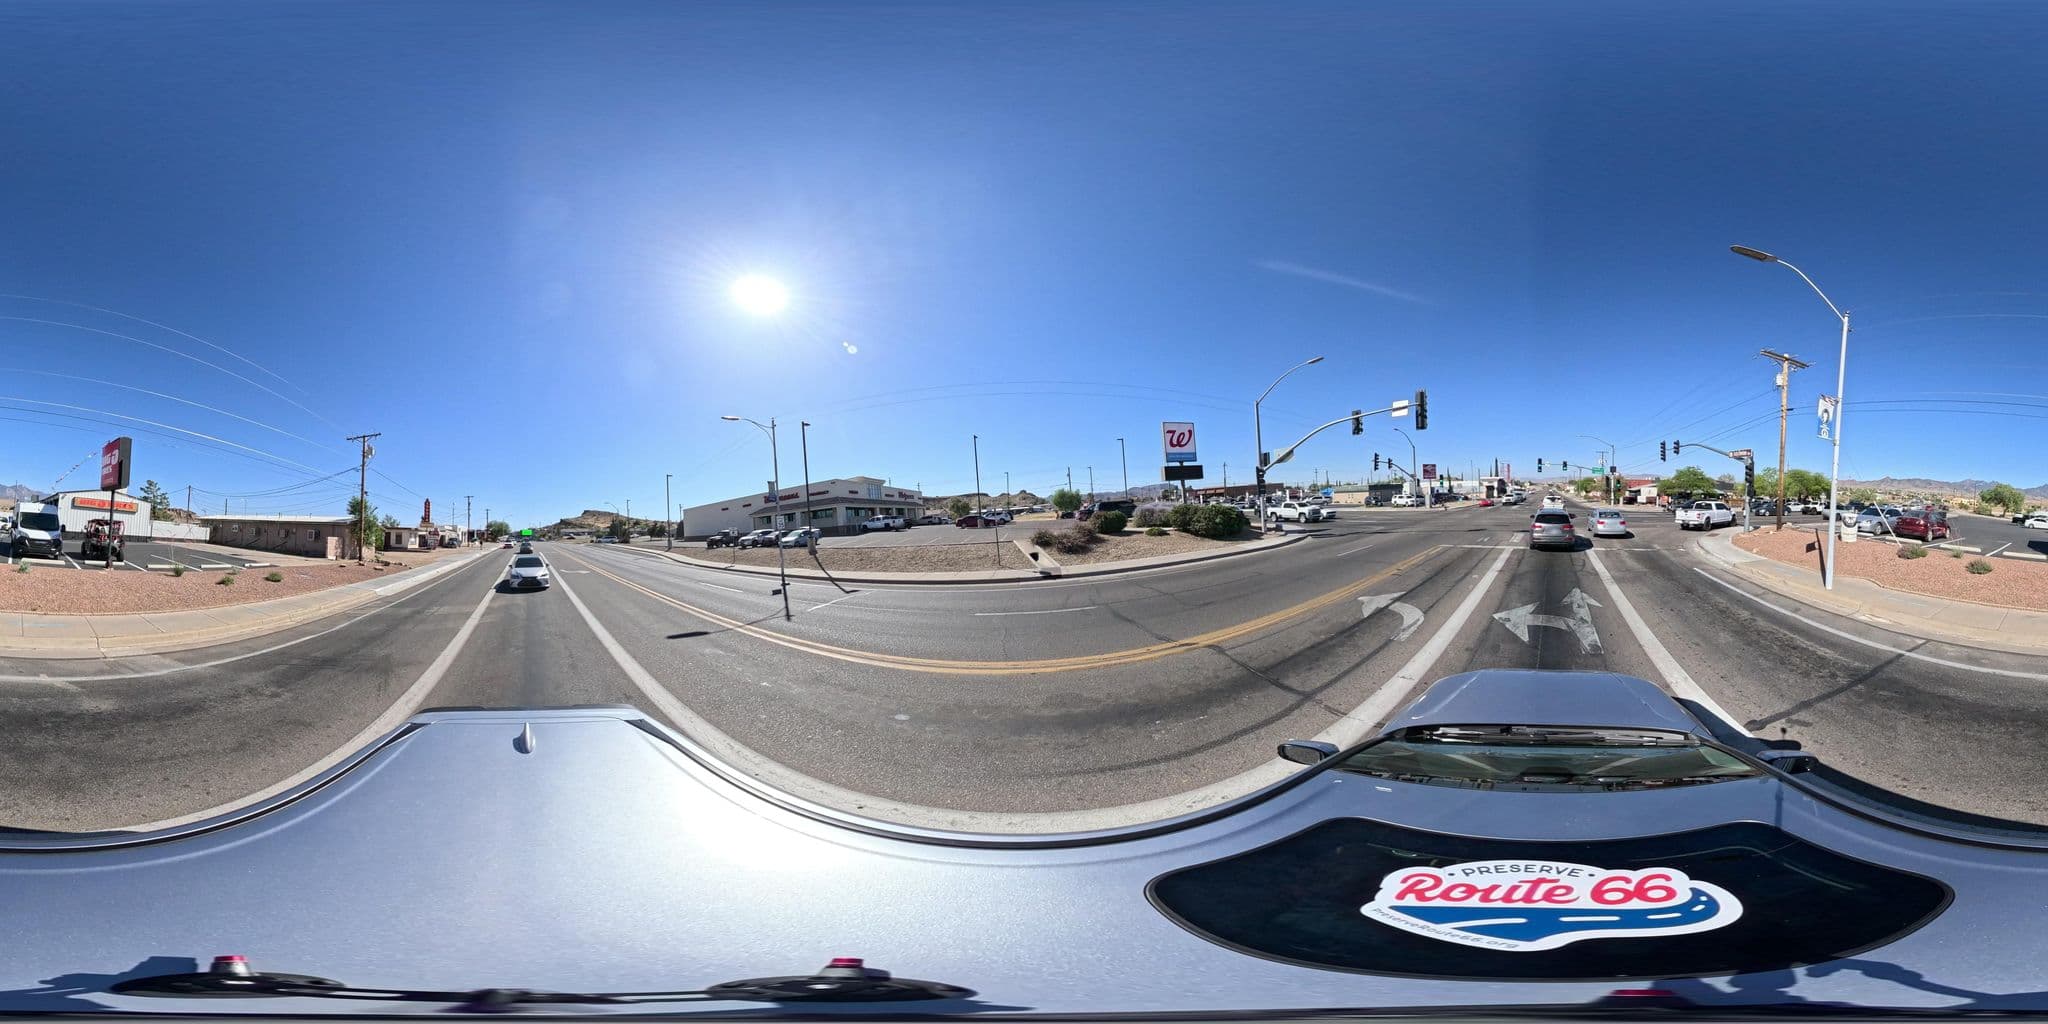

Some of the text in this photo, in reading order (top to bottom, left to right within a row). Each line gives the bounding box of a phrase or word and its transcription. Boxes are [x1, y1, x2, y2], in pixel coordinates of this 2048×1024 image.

[1461, 864, 1584, 877] PRESERVE
[1395, 873, 1677, 905] Route 66
